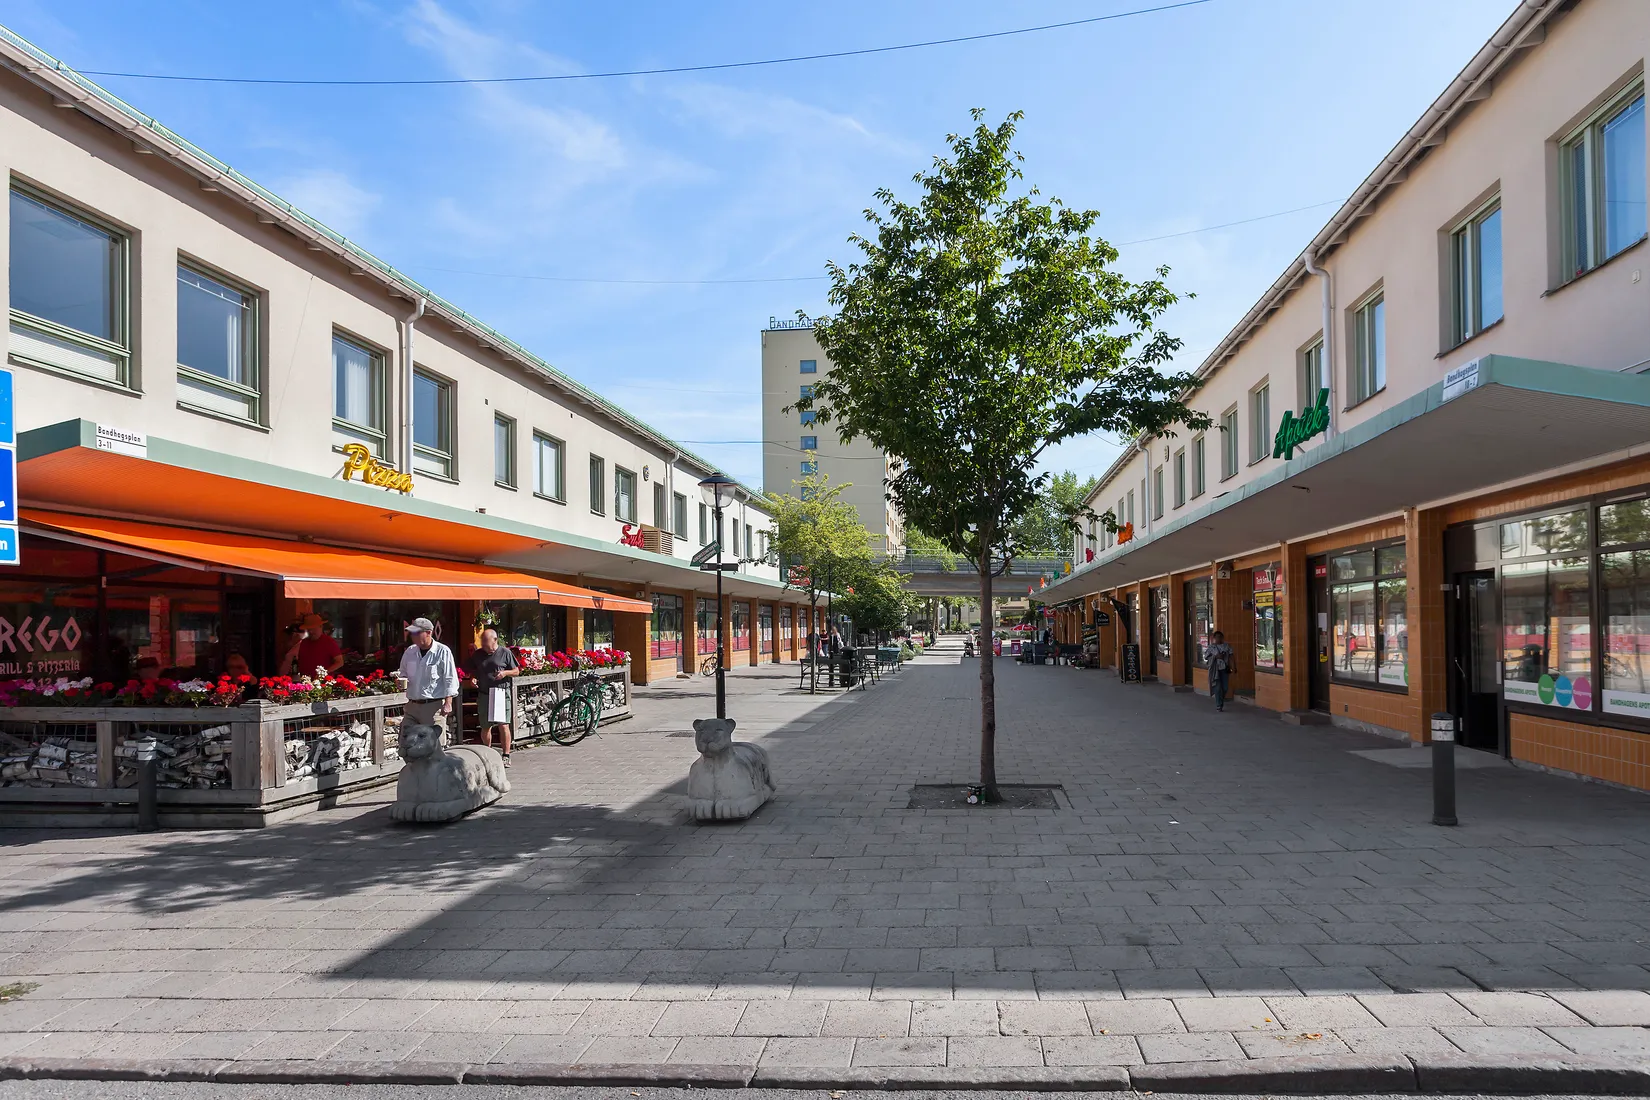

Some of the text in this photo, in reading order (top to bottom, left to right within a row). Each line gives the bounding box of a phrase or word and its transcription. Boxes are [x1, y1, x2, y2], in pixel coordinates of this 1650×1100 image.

[97, 425, 141, 443] Bandhagsplan
[1273, 387, 1330, 461] Apotek
[98, 439, 112, 449] 3-11
[342, 442, 415, 493] Pizza
